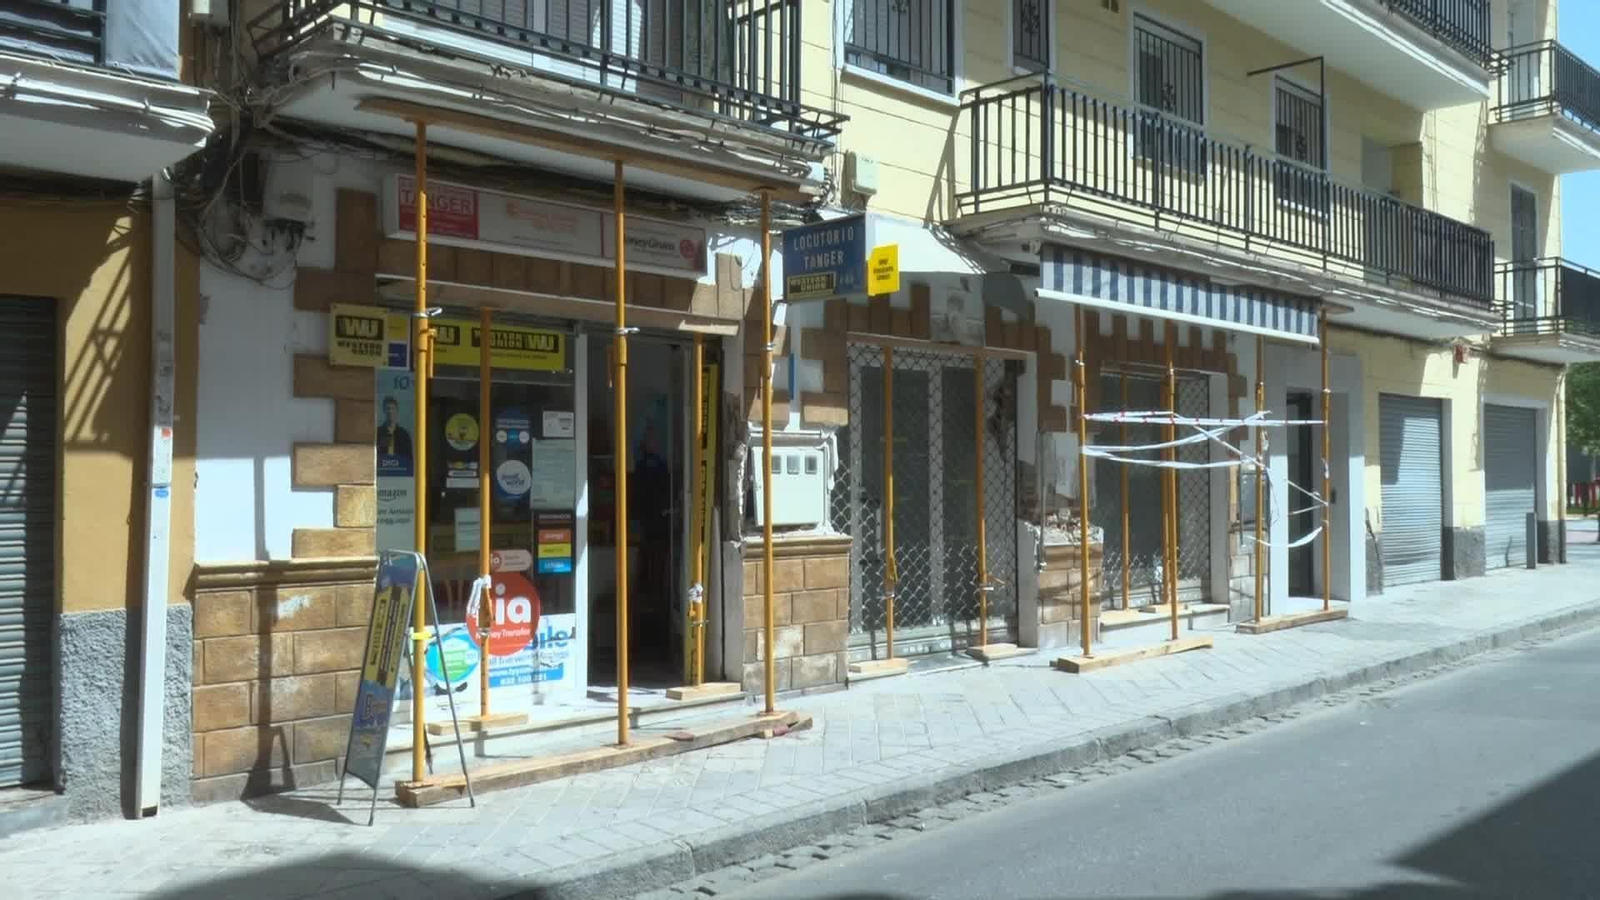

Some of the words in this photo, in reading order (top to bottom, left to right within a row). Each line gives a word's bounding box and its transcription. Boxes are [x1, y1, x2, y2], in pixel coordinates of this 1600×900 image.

[793, 226, 854, 251] LOCUTORIO
[804, 251, 844, 271] TANGER
[382, 459, 399, 467] DIGI
[476, 582, 531, 626] ia
